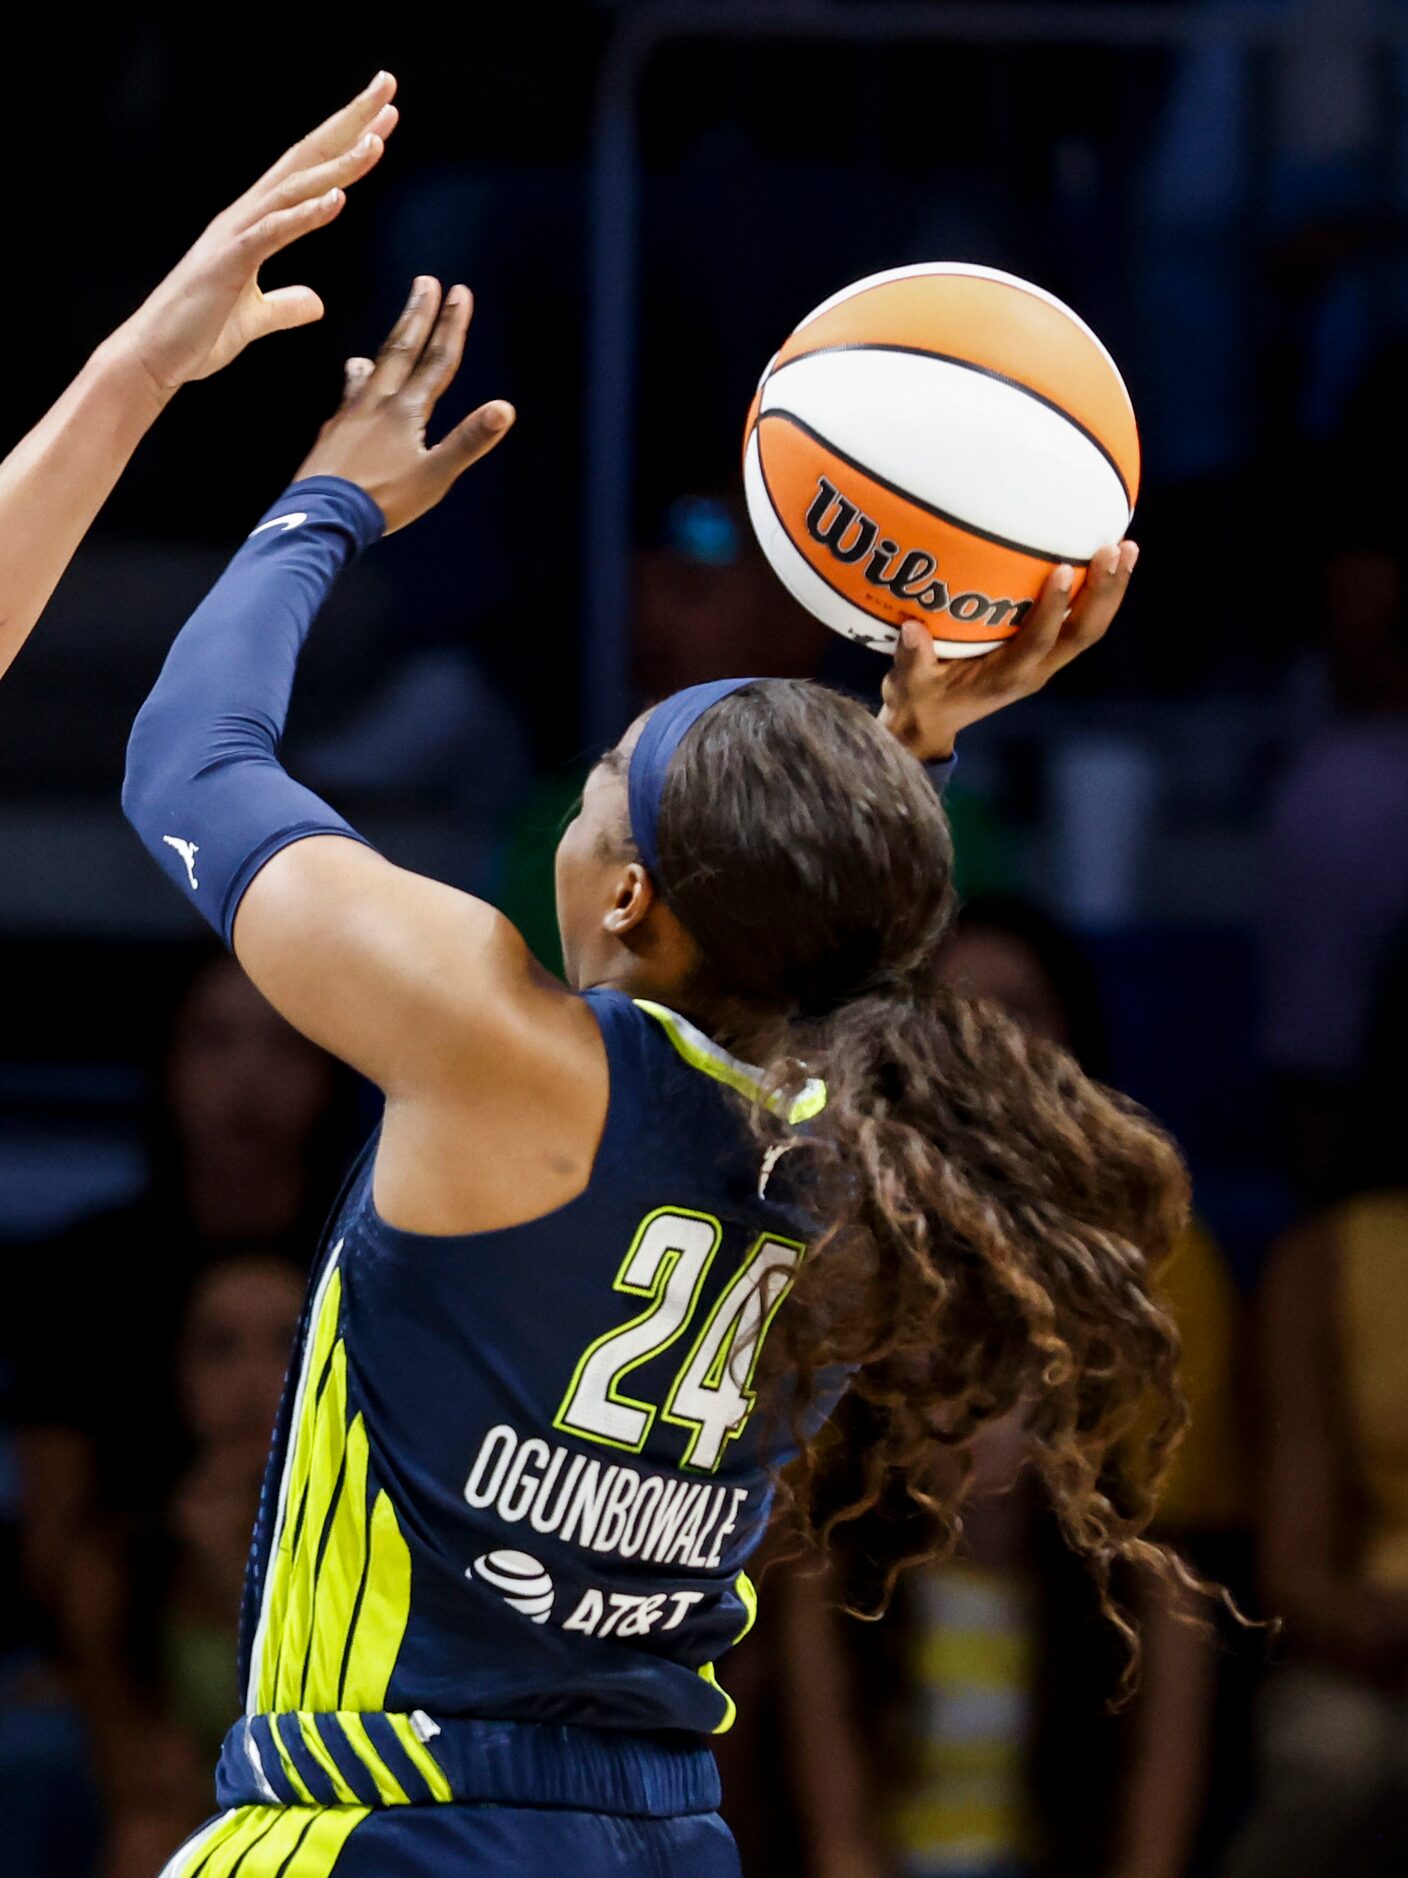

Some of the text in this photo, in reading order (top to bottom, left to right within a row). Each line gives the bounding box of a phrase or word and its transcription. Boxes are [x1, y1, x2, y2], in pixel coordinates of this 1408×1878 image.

[806, 476, 1035, 626] Wilson
[552, 1205, 806, 1474] 24
[464, 1424, 748, 1569] OGUNBOWALE
[562, 1589, 705, 1639] AT&T
